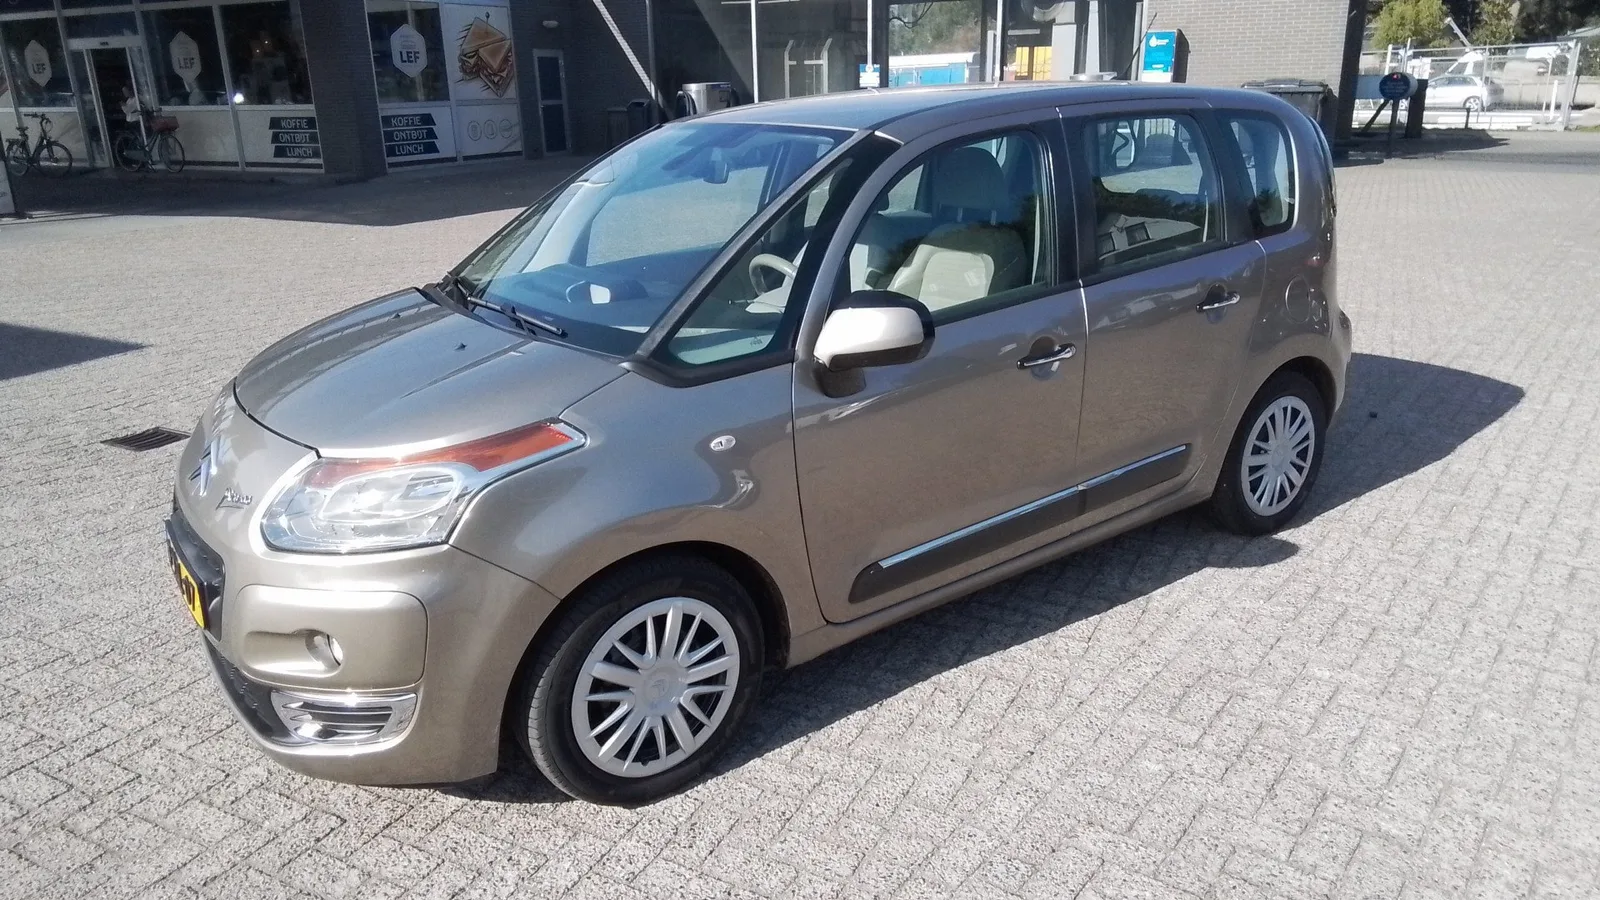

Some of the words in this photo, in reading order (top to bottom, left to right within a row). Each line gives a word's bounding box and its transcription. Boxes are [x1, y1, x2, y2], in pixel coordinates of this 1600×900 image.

[398, 50, 420, 63] LEF
[32, 63, 46, 74] LEF
[178, 57, 195, 69] LEF
[281, 119, 308, 129] KOFFIE
[391, 117, 421, 127] KOFFIE
[286, 147, 313, 157] LUNCH
[395, 144, 424, 155] LUNCH
